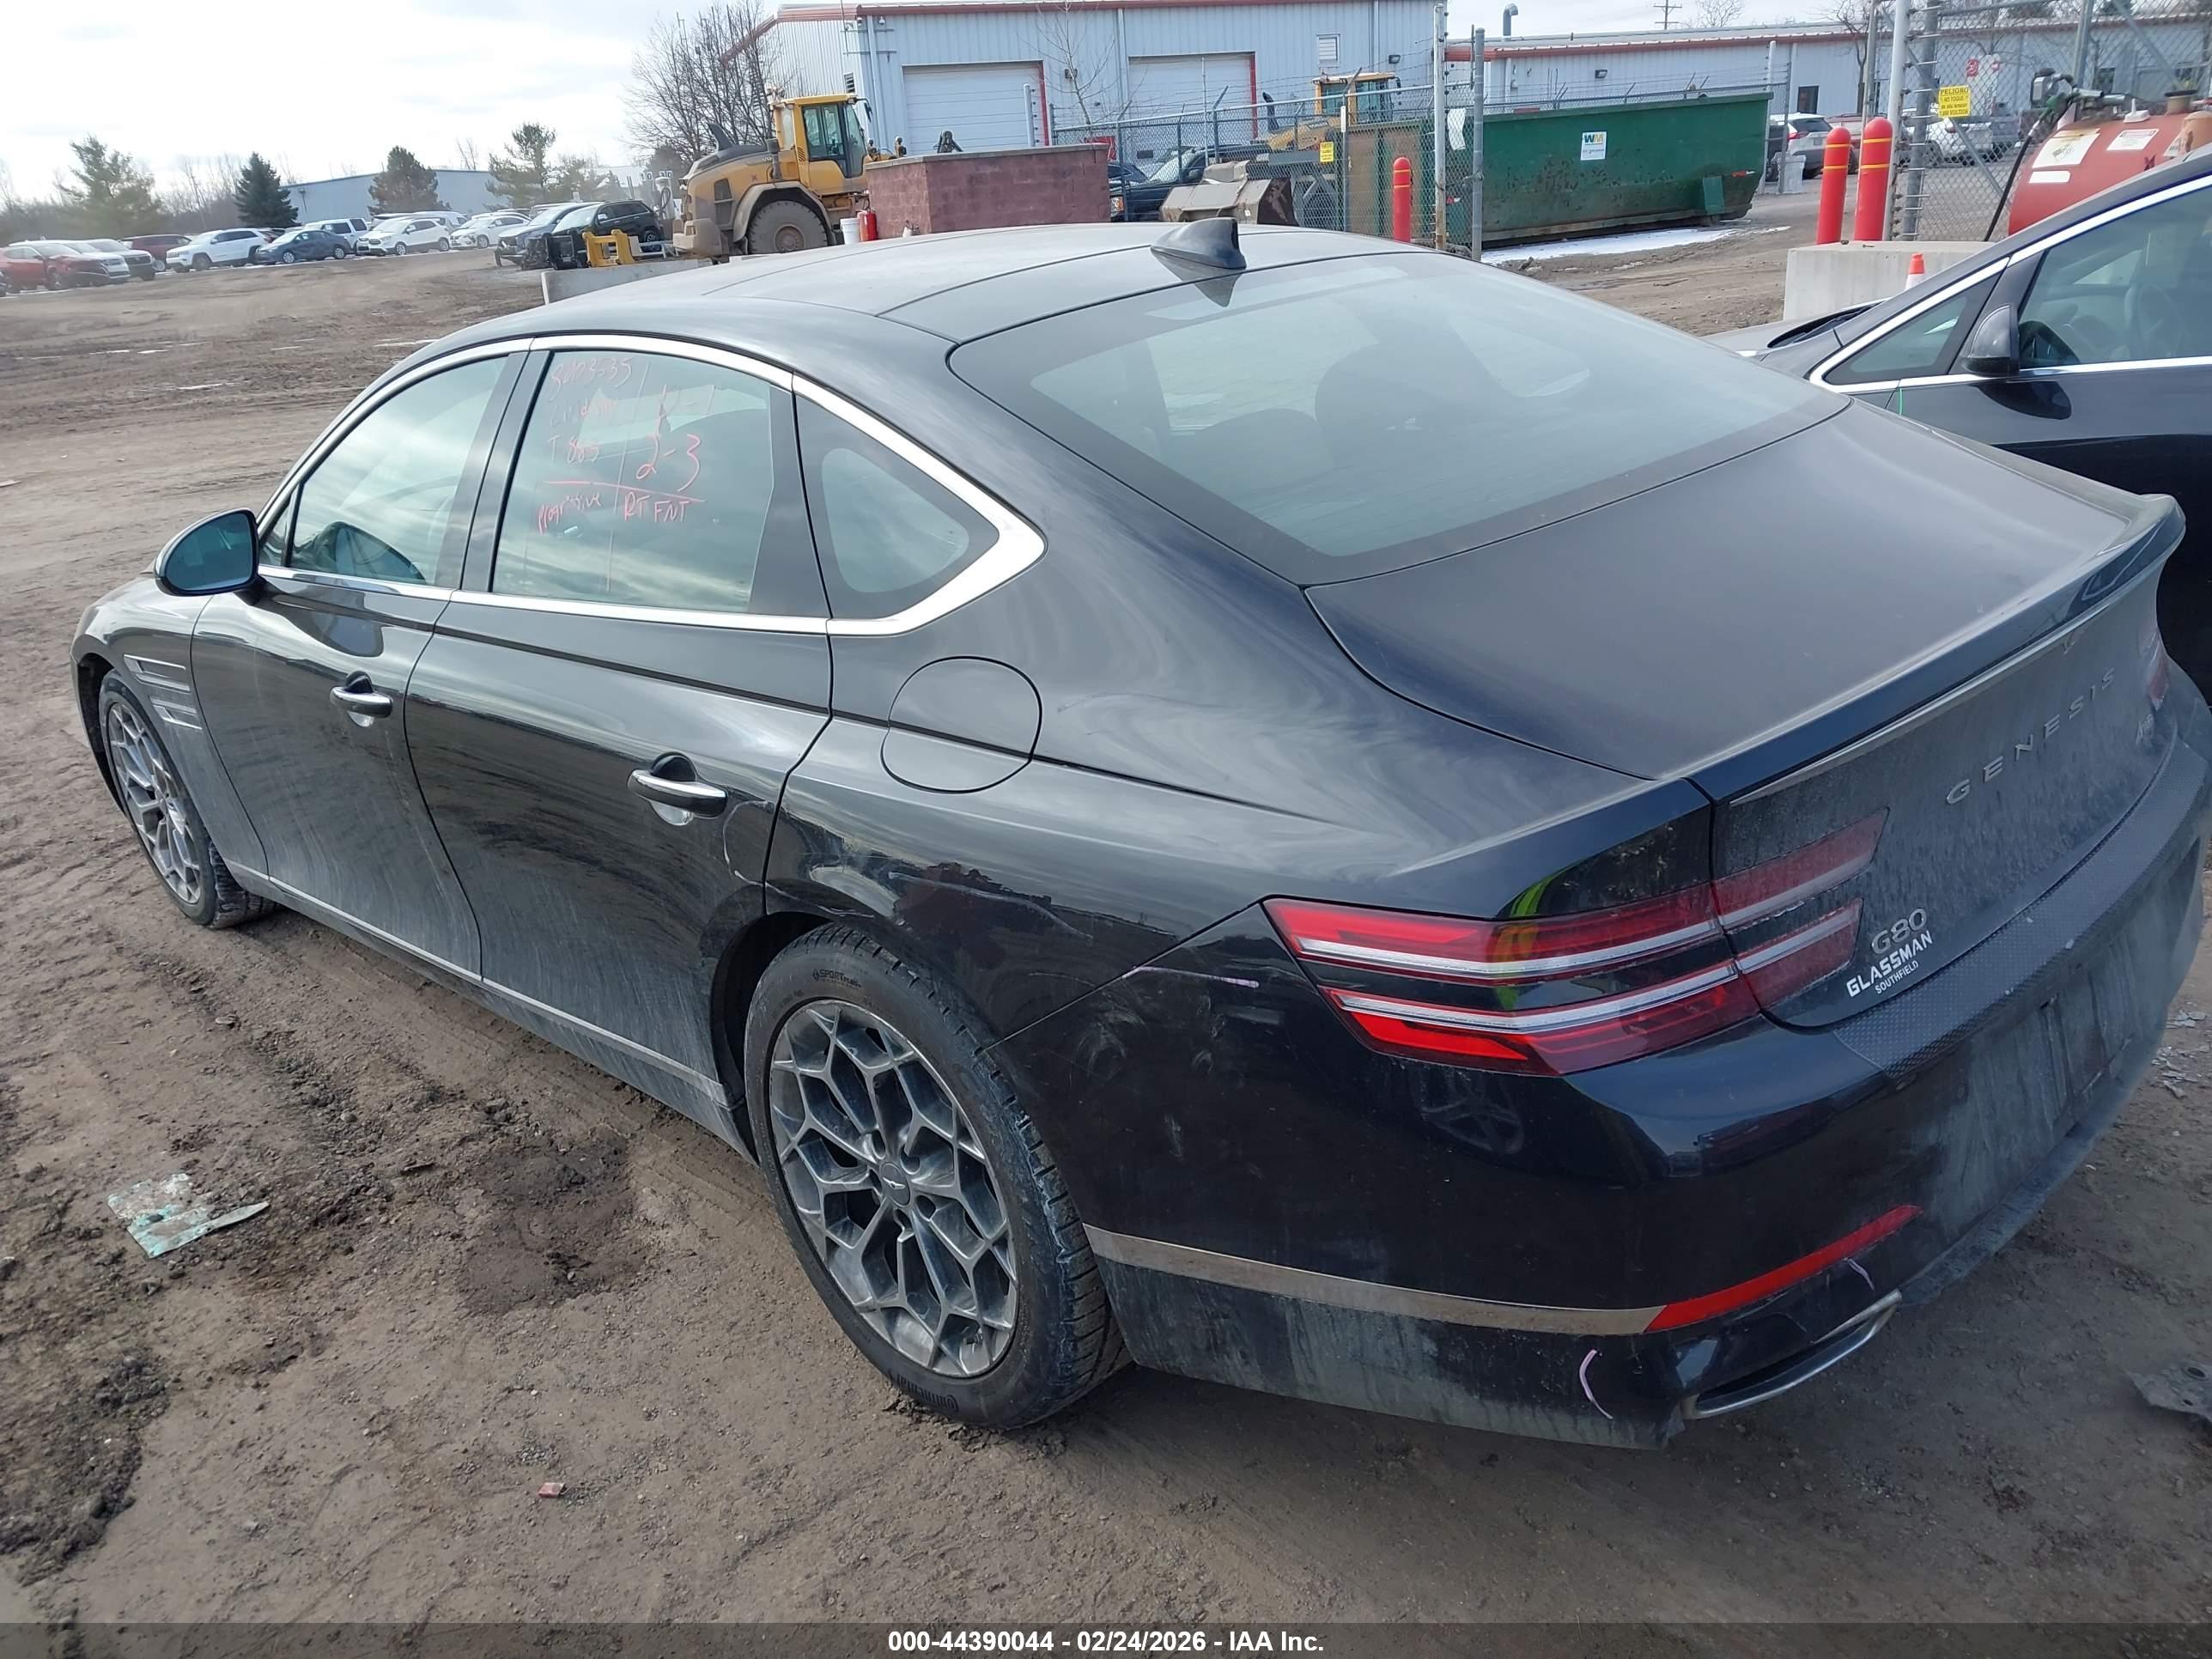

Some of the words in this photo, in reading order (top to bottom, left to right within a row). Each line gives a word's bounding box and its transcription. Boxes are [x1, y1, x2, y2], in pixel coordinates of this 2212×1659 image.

[1584, 134, 1603, 143] WM
[1946, 667, 2115, 805] GENESIS
[1872, 908, 1927, 954] G80
[1846, 930, 1933, 997] GLASSMAN
[1875, 960, 1919, 994] SOUTHFIELD
